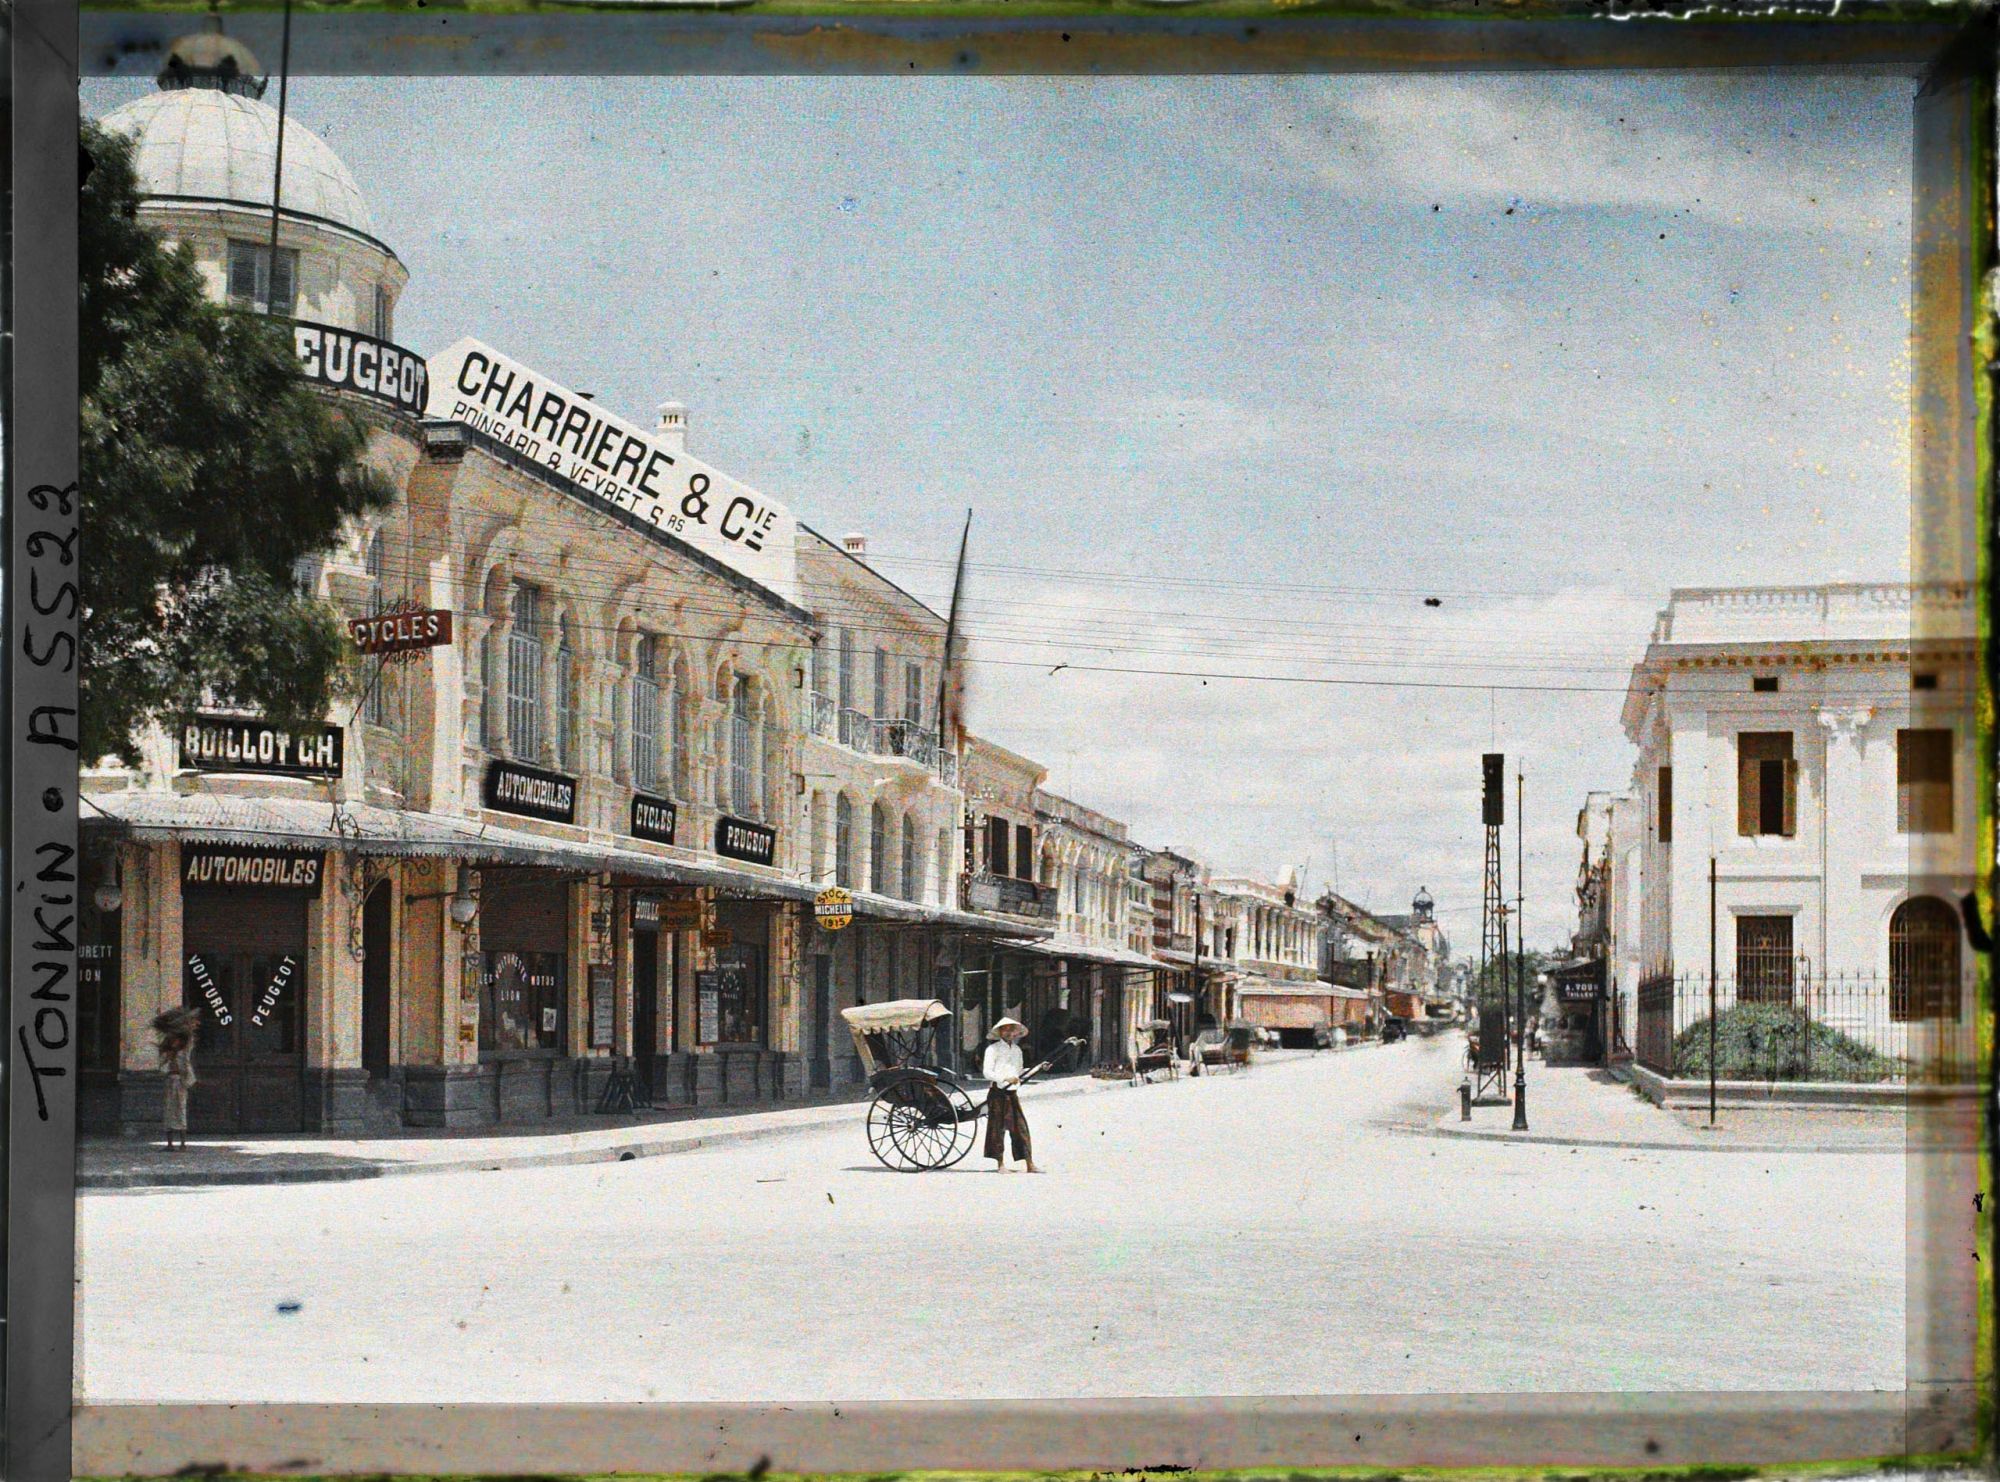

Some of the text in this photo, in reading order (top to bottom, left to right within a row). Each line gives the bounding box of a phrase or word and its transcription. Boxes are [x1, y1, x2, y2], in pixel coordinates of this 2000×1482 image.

[294, 326, 426, 410] EUGEOT
[457, 351, 675, 499] CHARRIERE
[680, 473, 707, 525] &
[449, 400, 541, 458] POINSARD
[569, 462, 643, 512] VEYRET
[355, 615, 439, 647] CYCLES
[26, 704, 79, 751] A
[497, 771, 572, 811] AUTOMOBILES
[636, 803, 673, 832] CYCLES
[727, 825, 771, 857] PEUGEOT
[186, 855, 317, 886] AUTOMOBILES
[814, 903, 852, 916] MICHELIN
[817, 889, 848, 904] STOCK
[823, 917, 846, 928] 1915
[78, 945, 112, 958] URETT
[188, 953, 233, 1027] VOITURES
[252, 954, 298, 1027] PEUGEOT
